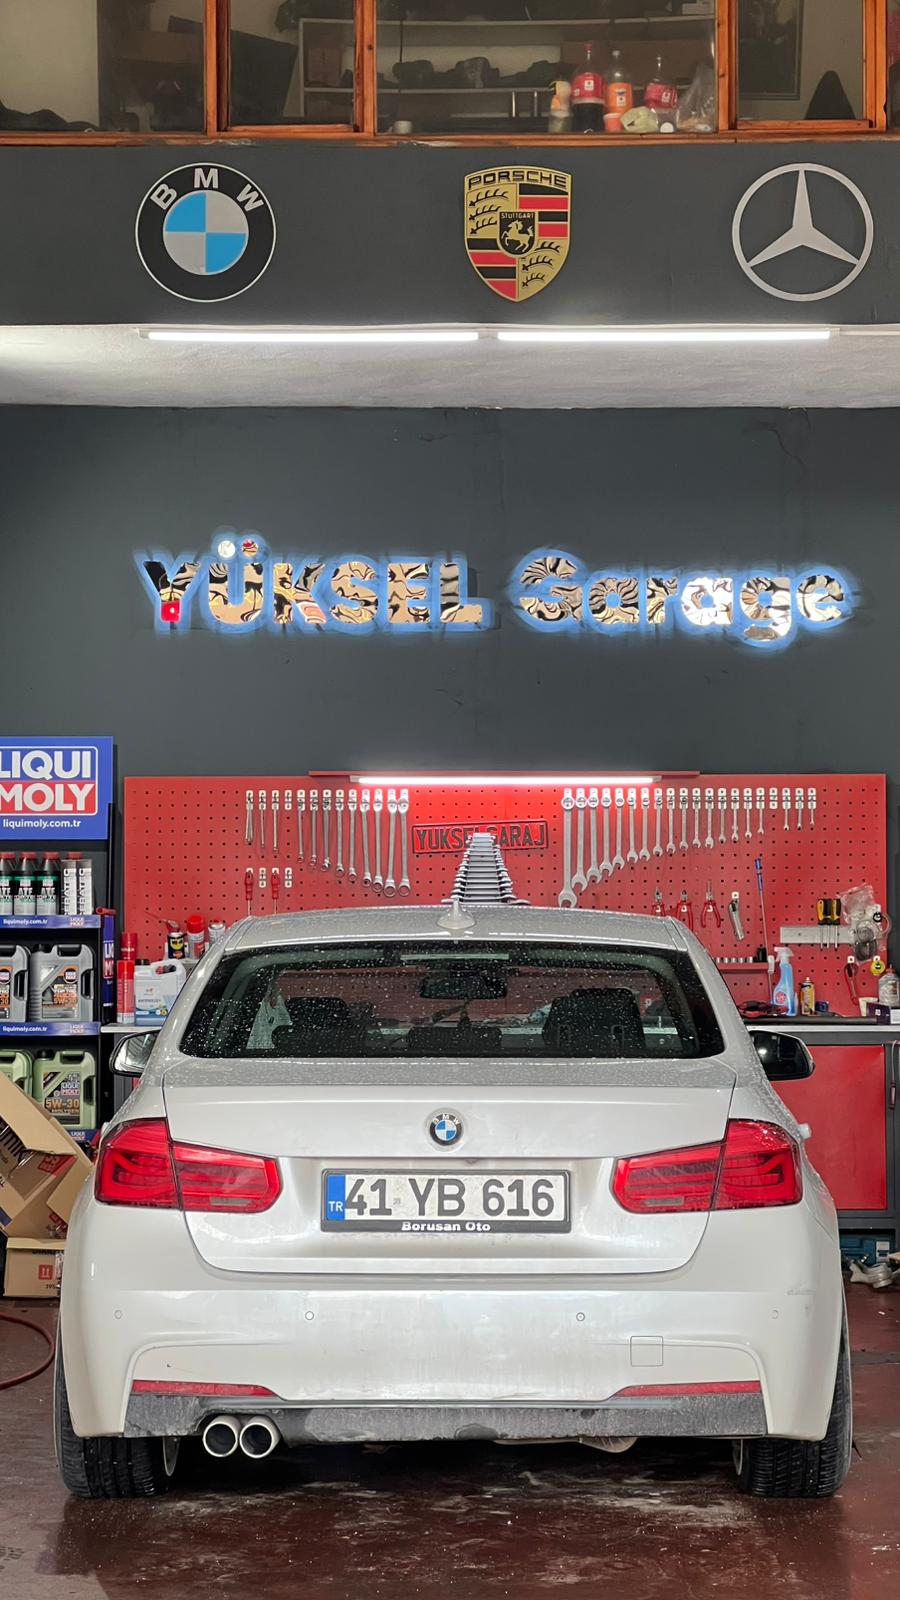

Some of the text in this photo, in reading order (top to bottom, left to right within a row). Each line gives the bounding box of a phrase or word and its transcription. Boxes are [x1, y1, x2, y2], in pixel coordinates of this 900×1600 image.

[150, 168, 264, 212] BMW
[468, 170, 567, 190] PORSCHE
[143, 539, 845, 641] YÜKSEL Garage
[0, 750, 91, 780] LIQUI
[0, 783, 95, 812] MOLY
[3, 819, 81, 829] liquimoly.com.tr
[46, 1099, 79, 1108] 5W-30
[432, 1113, 460, 1125] BMW
[328, 1178, 555, 1217] TR 41 YB 616
[401, 1222, 491, 1232] Borusan Oto
